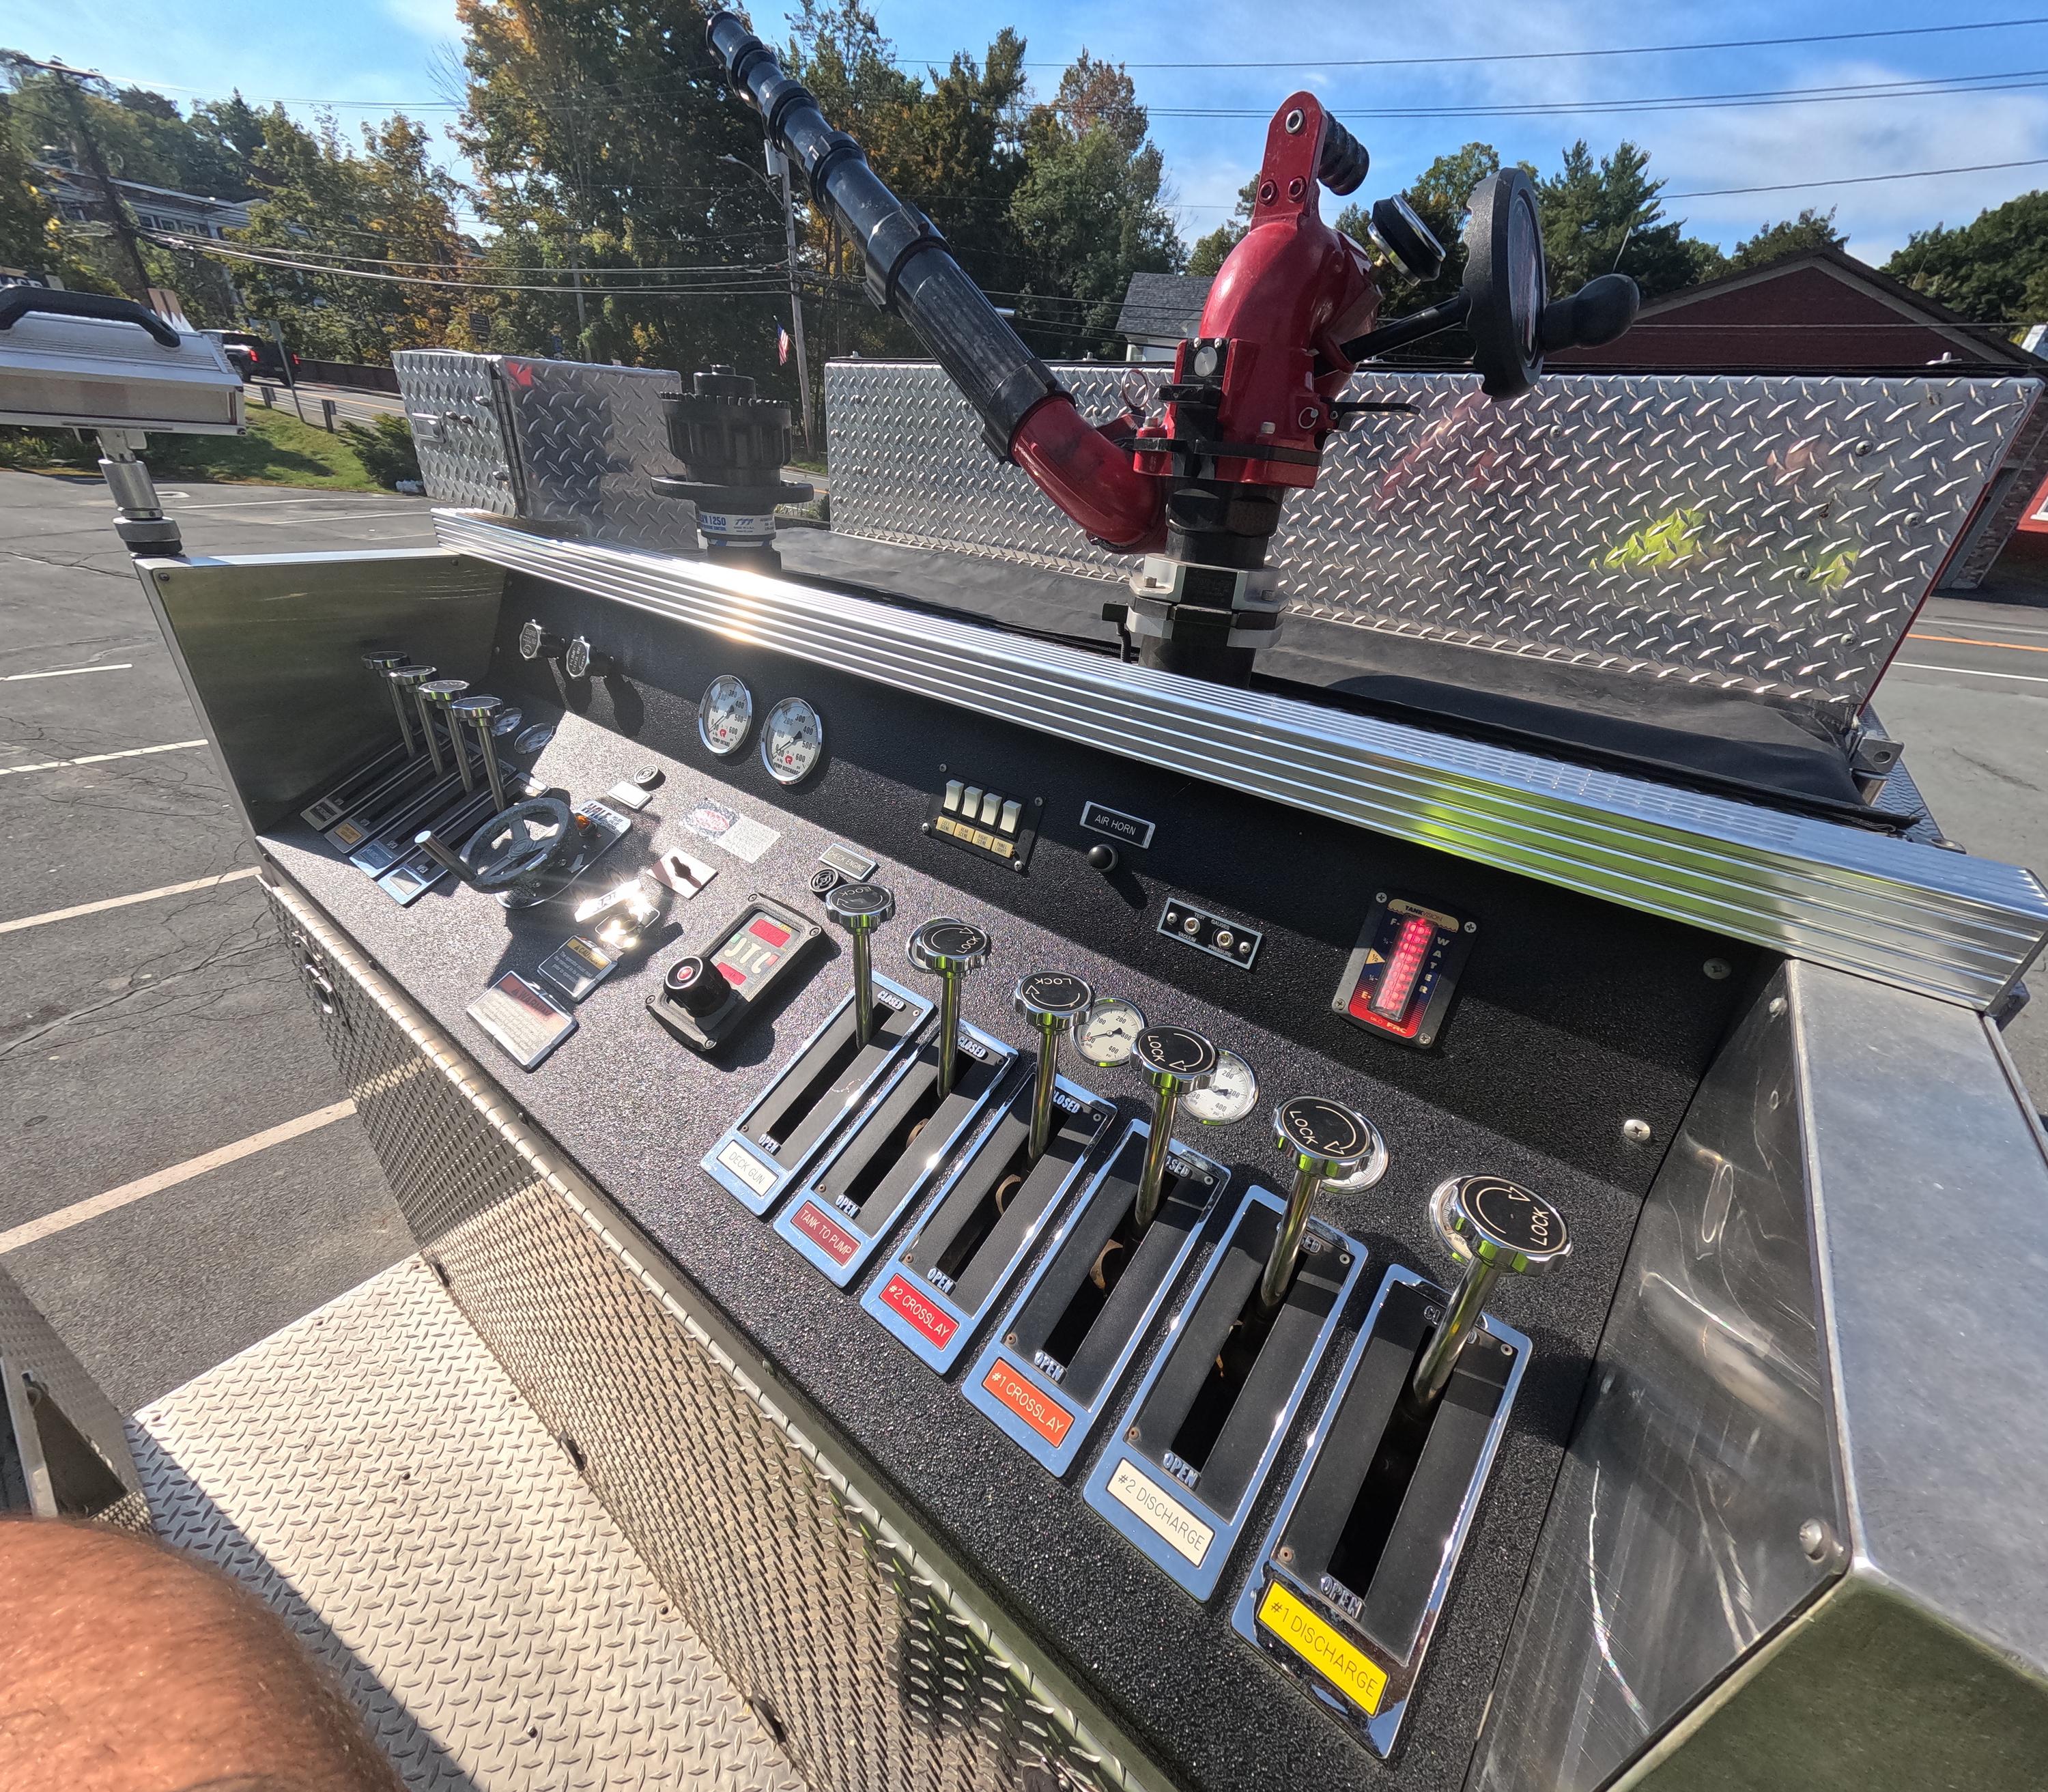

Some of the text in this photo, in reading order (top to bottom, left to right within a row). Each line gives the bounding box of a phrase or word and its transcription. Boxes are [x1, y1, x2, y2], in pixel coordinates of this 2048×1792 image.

[710, 516, 726, 526] 1250
[735, 700, 745, 709] 400
[735, 714, 743, 723] 500
[795, 714, 806, 723] 300
[728, 726, 738, 735] 600
[803, 726, 814, 735] 400
[801, 741, 812, 750] 500
[795, 753, 806, 763] 600
[1094, 814, 1136, 836] AIR HORN
[827, 850, 866, 872] CHECK ENGINE
[838, 886, 872, 897] LOCK
[1195, 912, 1231, 930] TEST GAUGES
[956, 935, 982, 954] LOCK
[1178, 930, 1197, 943] VACUUM
[1208, 943, 1234, 958] PRESSURE
[1034, 978, 1071, 986] LOCK
[877, 990, 905, 1010] CLOSED
[1097, 1017, 1107, 1025] 100
[1115, 1016, 1127, 1024] 200
[1120, 1032, 1132, 1041] 300
[957, 1035, 987, 1058] CLOSED
[1108, 1045, 1120, 1054] 400
[1147, 1034, 1166, 1063] LOCK
[1221, 1070, 1234, 1079] 200
[1052, 1090, 1081, 1113] LOSED
[1229, 1088, 1240, 1098] 300
[1215, 1103, 1227, 1112] 400
[1289, 1110, 1320, 1146] LOCK
[757, 1134, 778, 1154] OPEN
[728, 1151, 765, 1186] DECK GUN
[834, 1195, 859, 1218] OPEN
[800, 1209, 853, 1257] TANK TO PUMP
[1529, 1206, 1550, 1247] LOCK
[926, 1268, 954, 1294] OPEN
[888, 1284, 950, 1337] #2 CROSSLAY
[1034, 1350, 1064, 1380] OPEN
[991, 1371, 1064, 1434] #1 CROSSLAY
[1162, 1452, 1199, 1488] OPEN
[1118, 1473, 1206, 1552] #2 DISCHARGE
[1320, 1576, 1363, 1619] OPEN
[1270, 1601, 1378, 1698] #1 DISCHARGE
